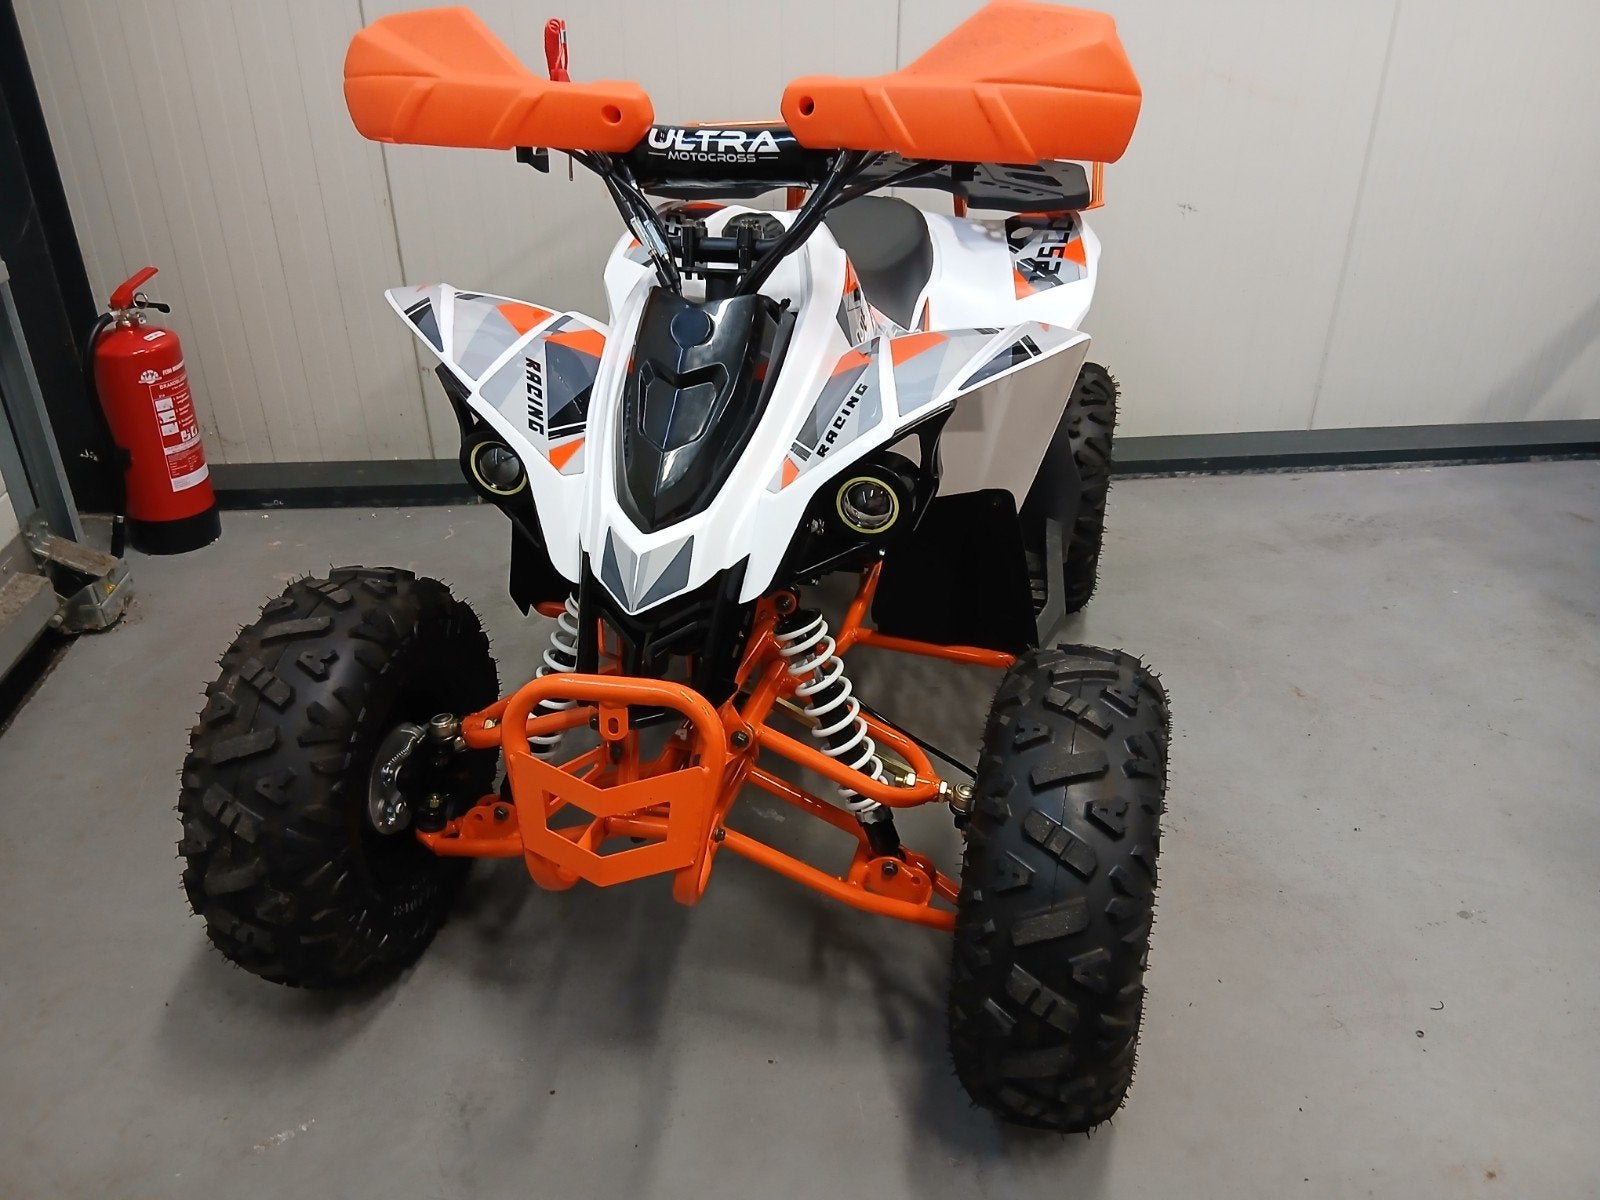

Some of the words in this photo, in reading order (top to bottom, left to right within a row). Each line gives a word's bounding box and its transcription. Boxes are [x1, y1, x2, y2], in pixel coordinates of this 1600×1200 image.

[648, 128, 781, 153] ULTRA
[667, 151, 756, 163] MOTOCROSS
[525, 357, 545, 436] RACING
[816, 383, 869, 458] RACING
